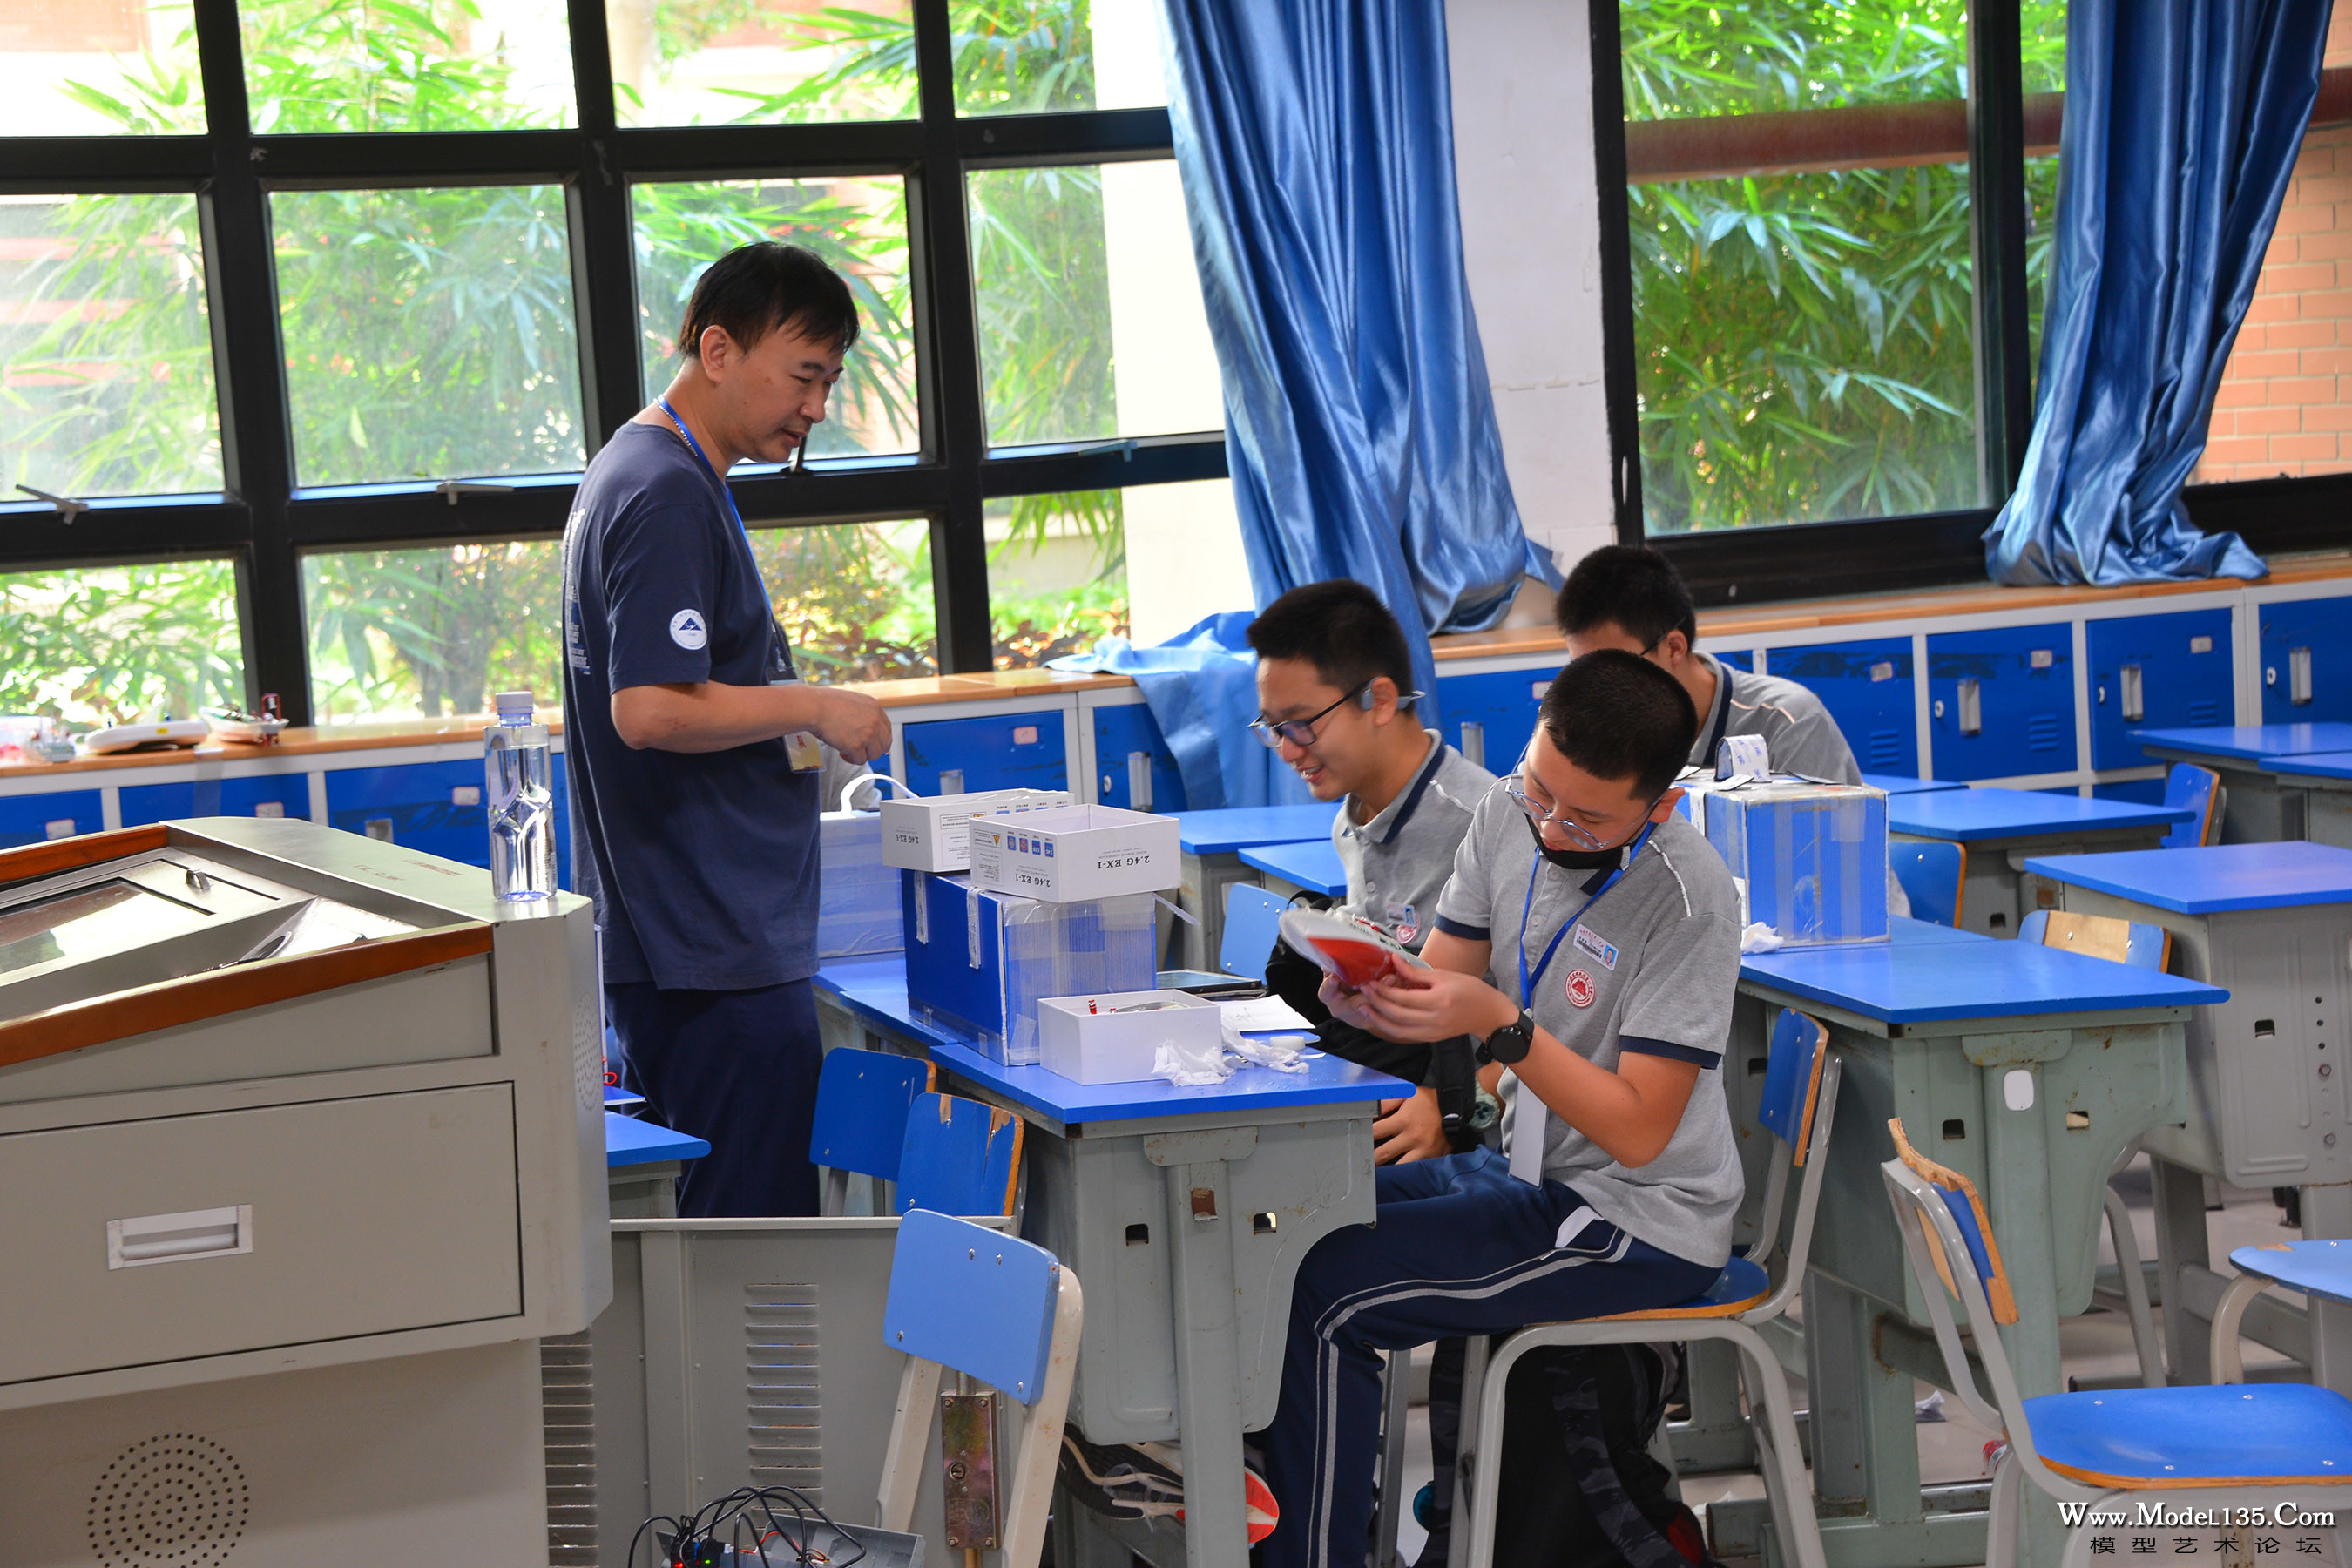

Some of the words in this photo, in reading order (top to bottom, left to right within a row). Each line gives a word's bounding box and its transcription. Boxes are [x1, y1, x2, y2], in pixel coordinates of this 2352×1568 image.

[1098, 859, 1121, 869] EX-1
[1126, 855, 1150, 866] 2.4G
[1015, 874, 1031, 883] EX-1
[1034, 877, 1051, 887] 2.4G
